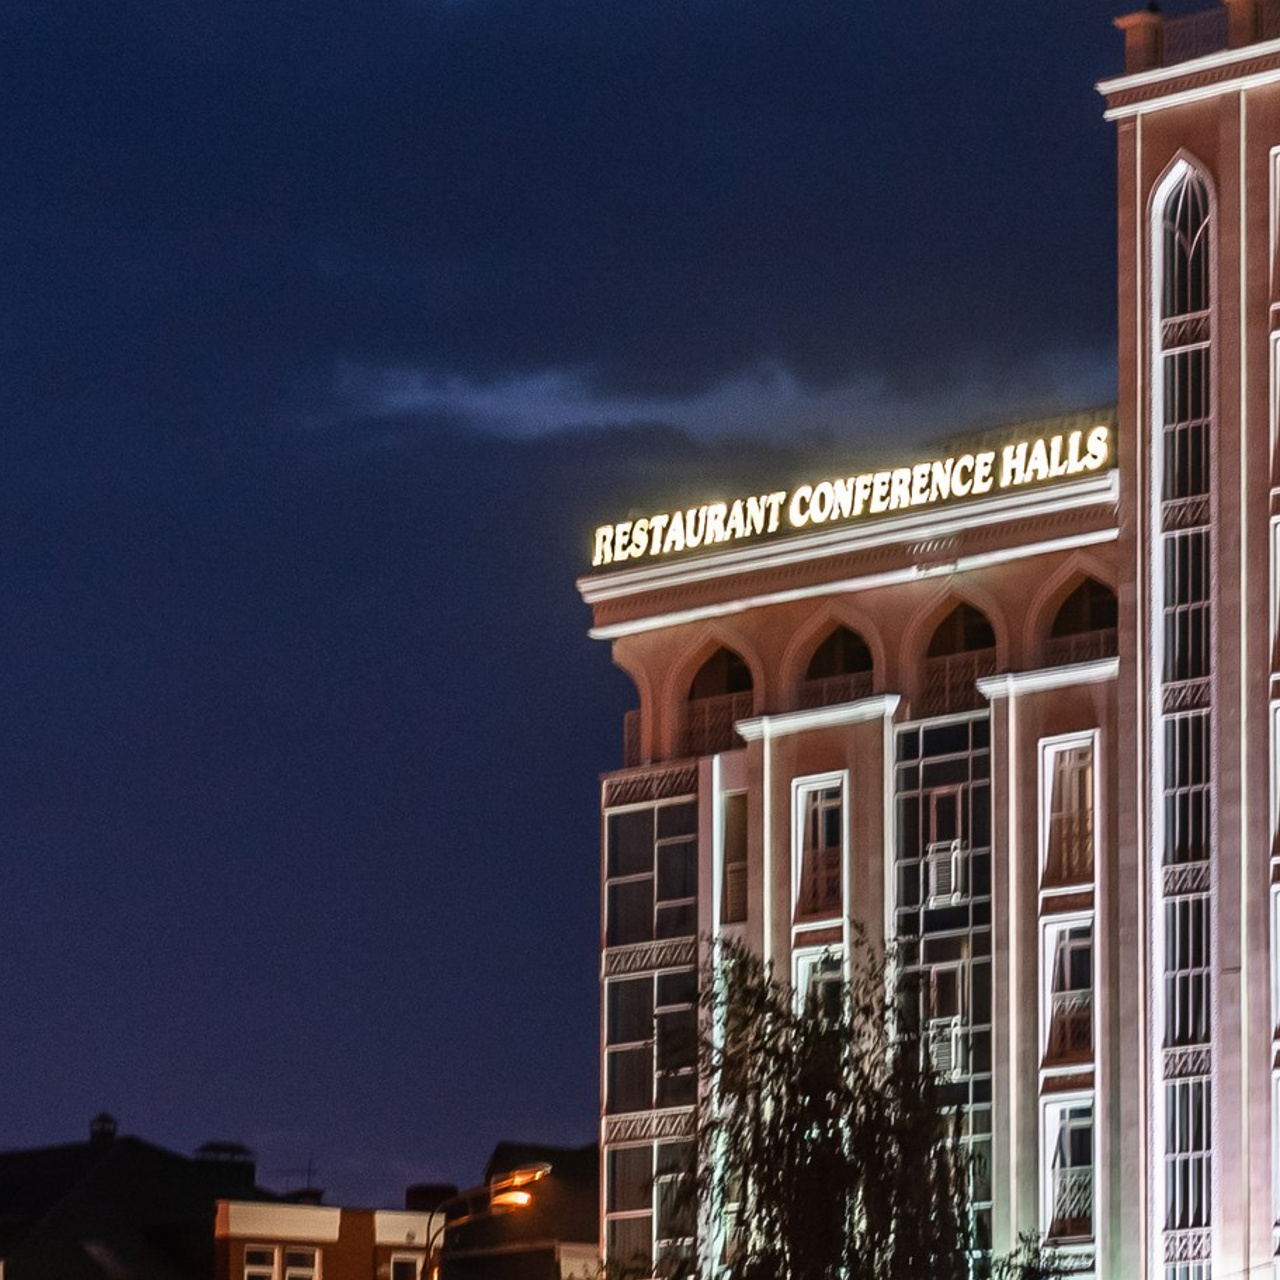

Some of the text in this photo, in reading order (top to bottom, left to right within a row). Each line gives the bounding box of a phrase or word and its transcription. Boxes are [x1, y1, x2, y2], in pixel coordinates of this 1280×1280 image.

[592, 426, 1109, 567] RESTAURANT CONFERENCE HALLS
